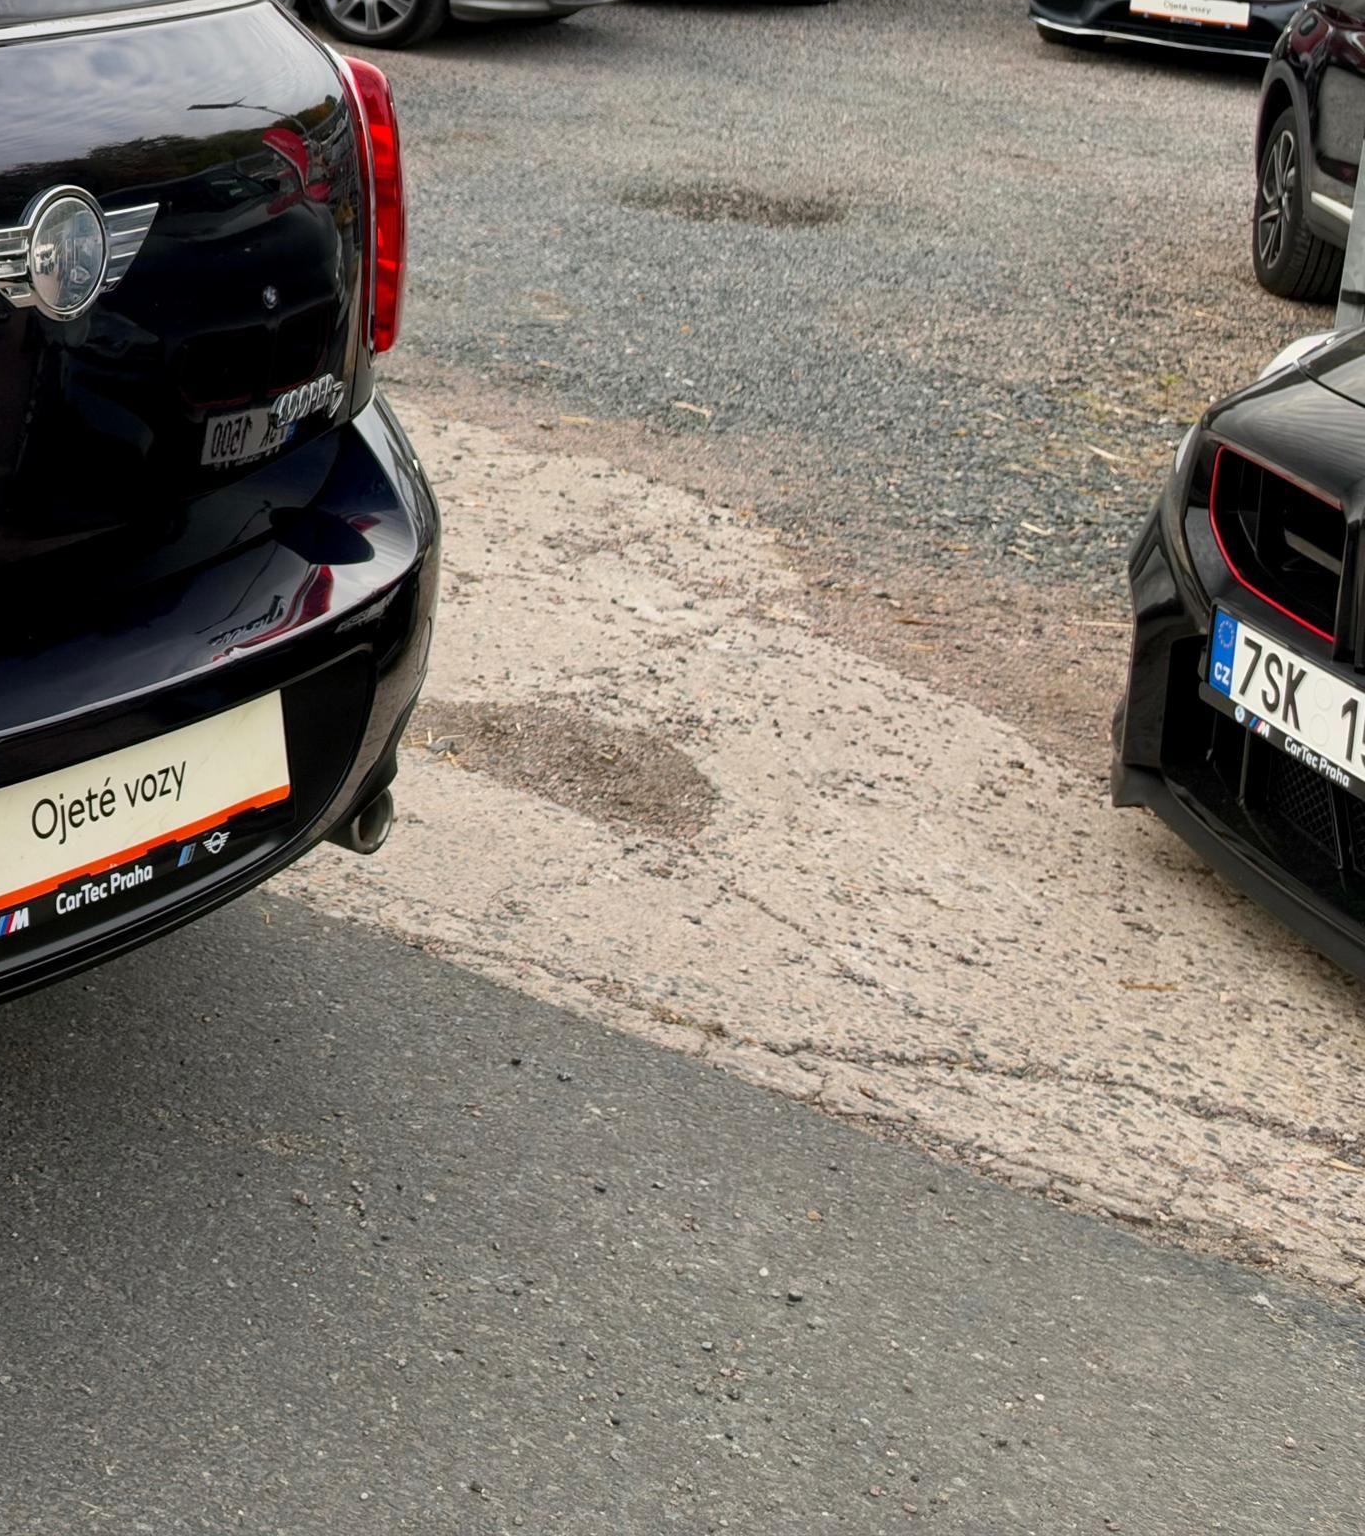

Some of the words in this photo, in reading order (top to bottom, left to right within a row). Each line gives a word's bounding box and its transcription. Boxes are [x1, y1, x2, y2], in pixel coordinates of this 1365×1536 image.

[1214, 662, 1231, 687] CZ
[1239, 636, 1307, 732] 7SK
[1284, 736, 1318, 769] CarTec
[1319, 757, 1350, 788] Praha
[32, 777, 116, 845] Ojeté
[124, 761, 187, 808] vozy
[56, 882, 108, 916] CarTec
[110, 864, 153, 895] Praha
